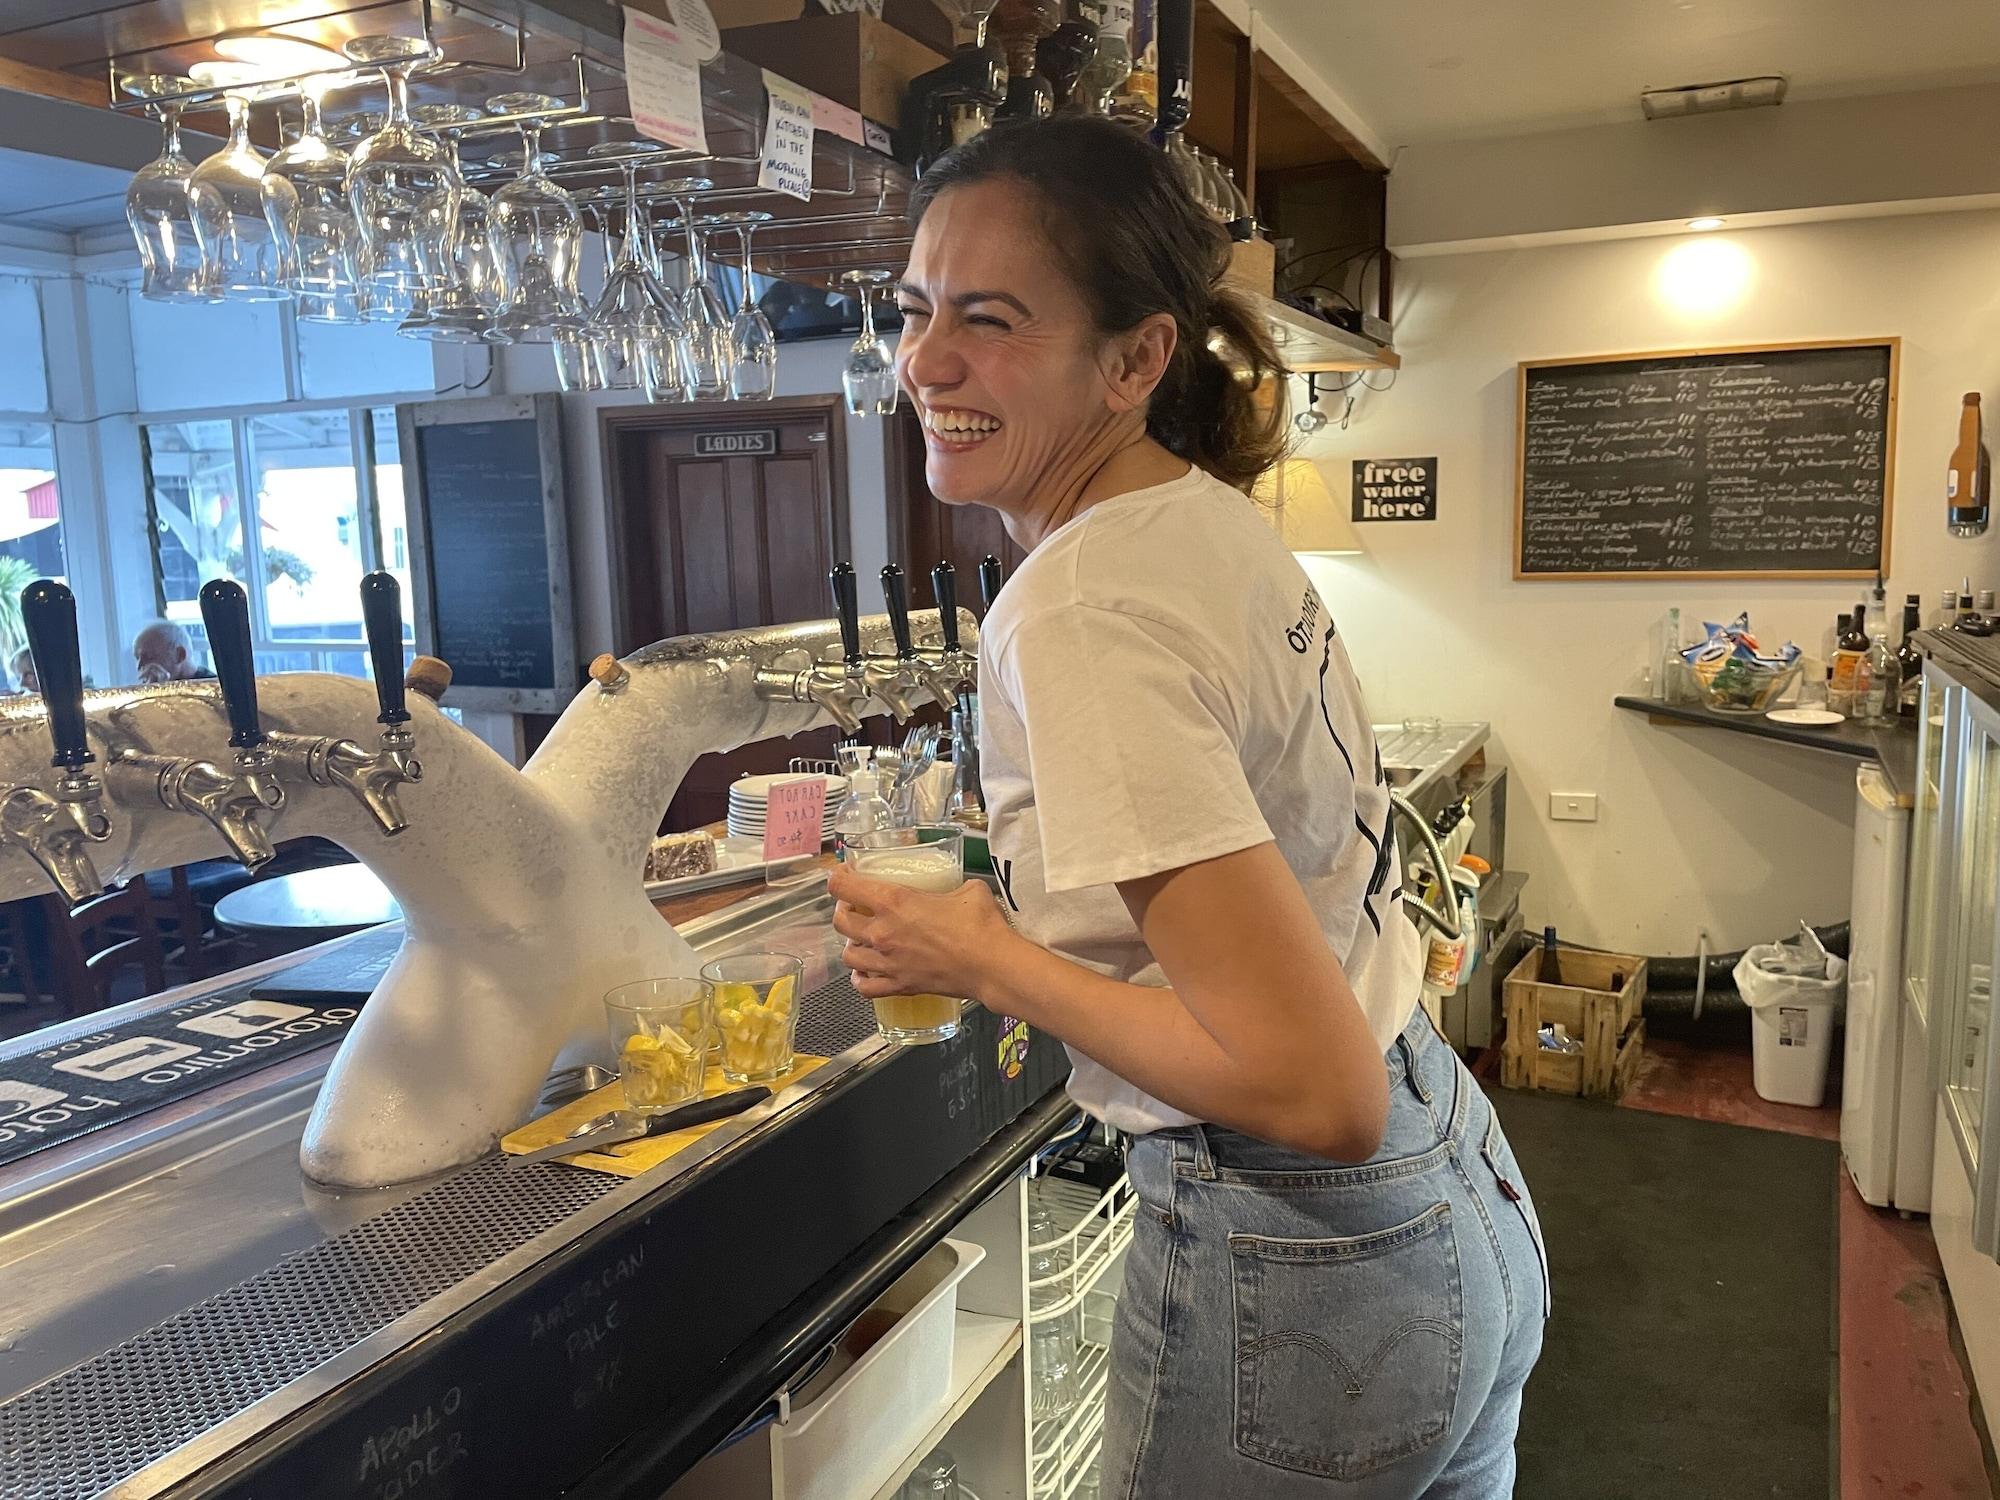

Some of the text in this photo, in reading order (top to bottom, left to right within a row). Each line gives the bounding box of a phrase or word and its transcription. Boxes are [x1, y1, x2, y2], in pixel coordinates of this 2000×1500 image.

[789, 141, 805, 155] THE
[705, 435, 764, 451] LADIES
[1363, 462, 1426, 484] free
[1362, 484, 1426, 498] water
[1363, 499, 1426, 518] here
[35, 1032, 115, 1059] moe
[140, 1006, 358, 1085] otoromiro
[566, 1300, 621, 1360] PALE
[358, 1386, 462, 1482] APOLLO
